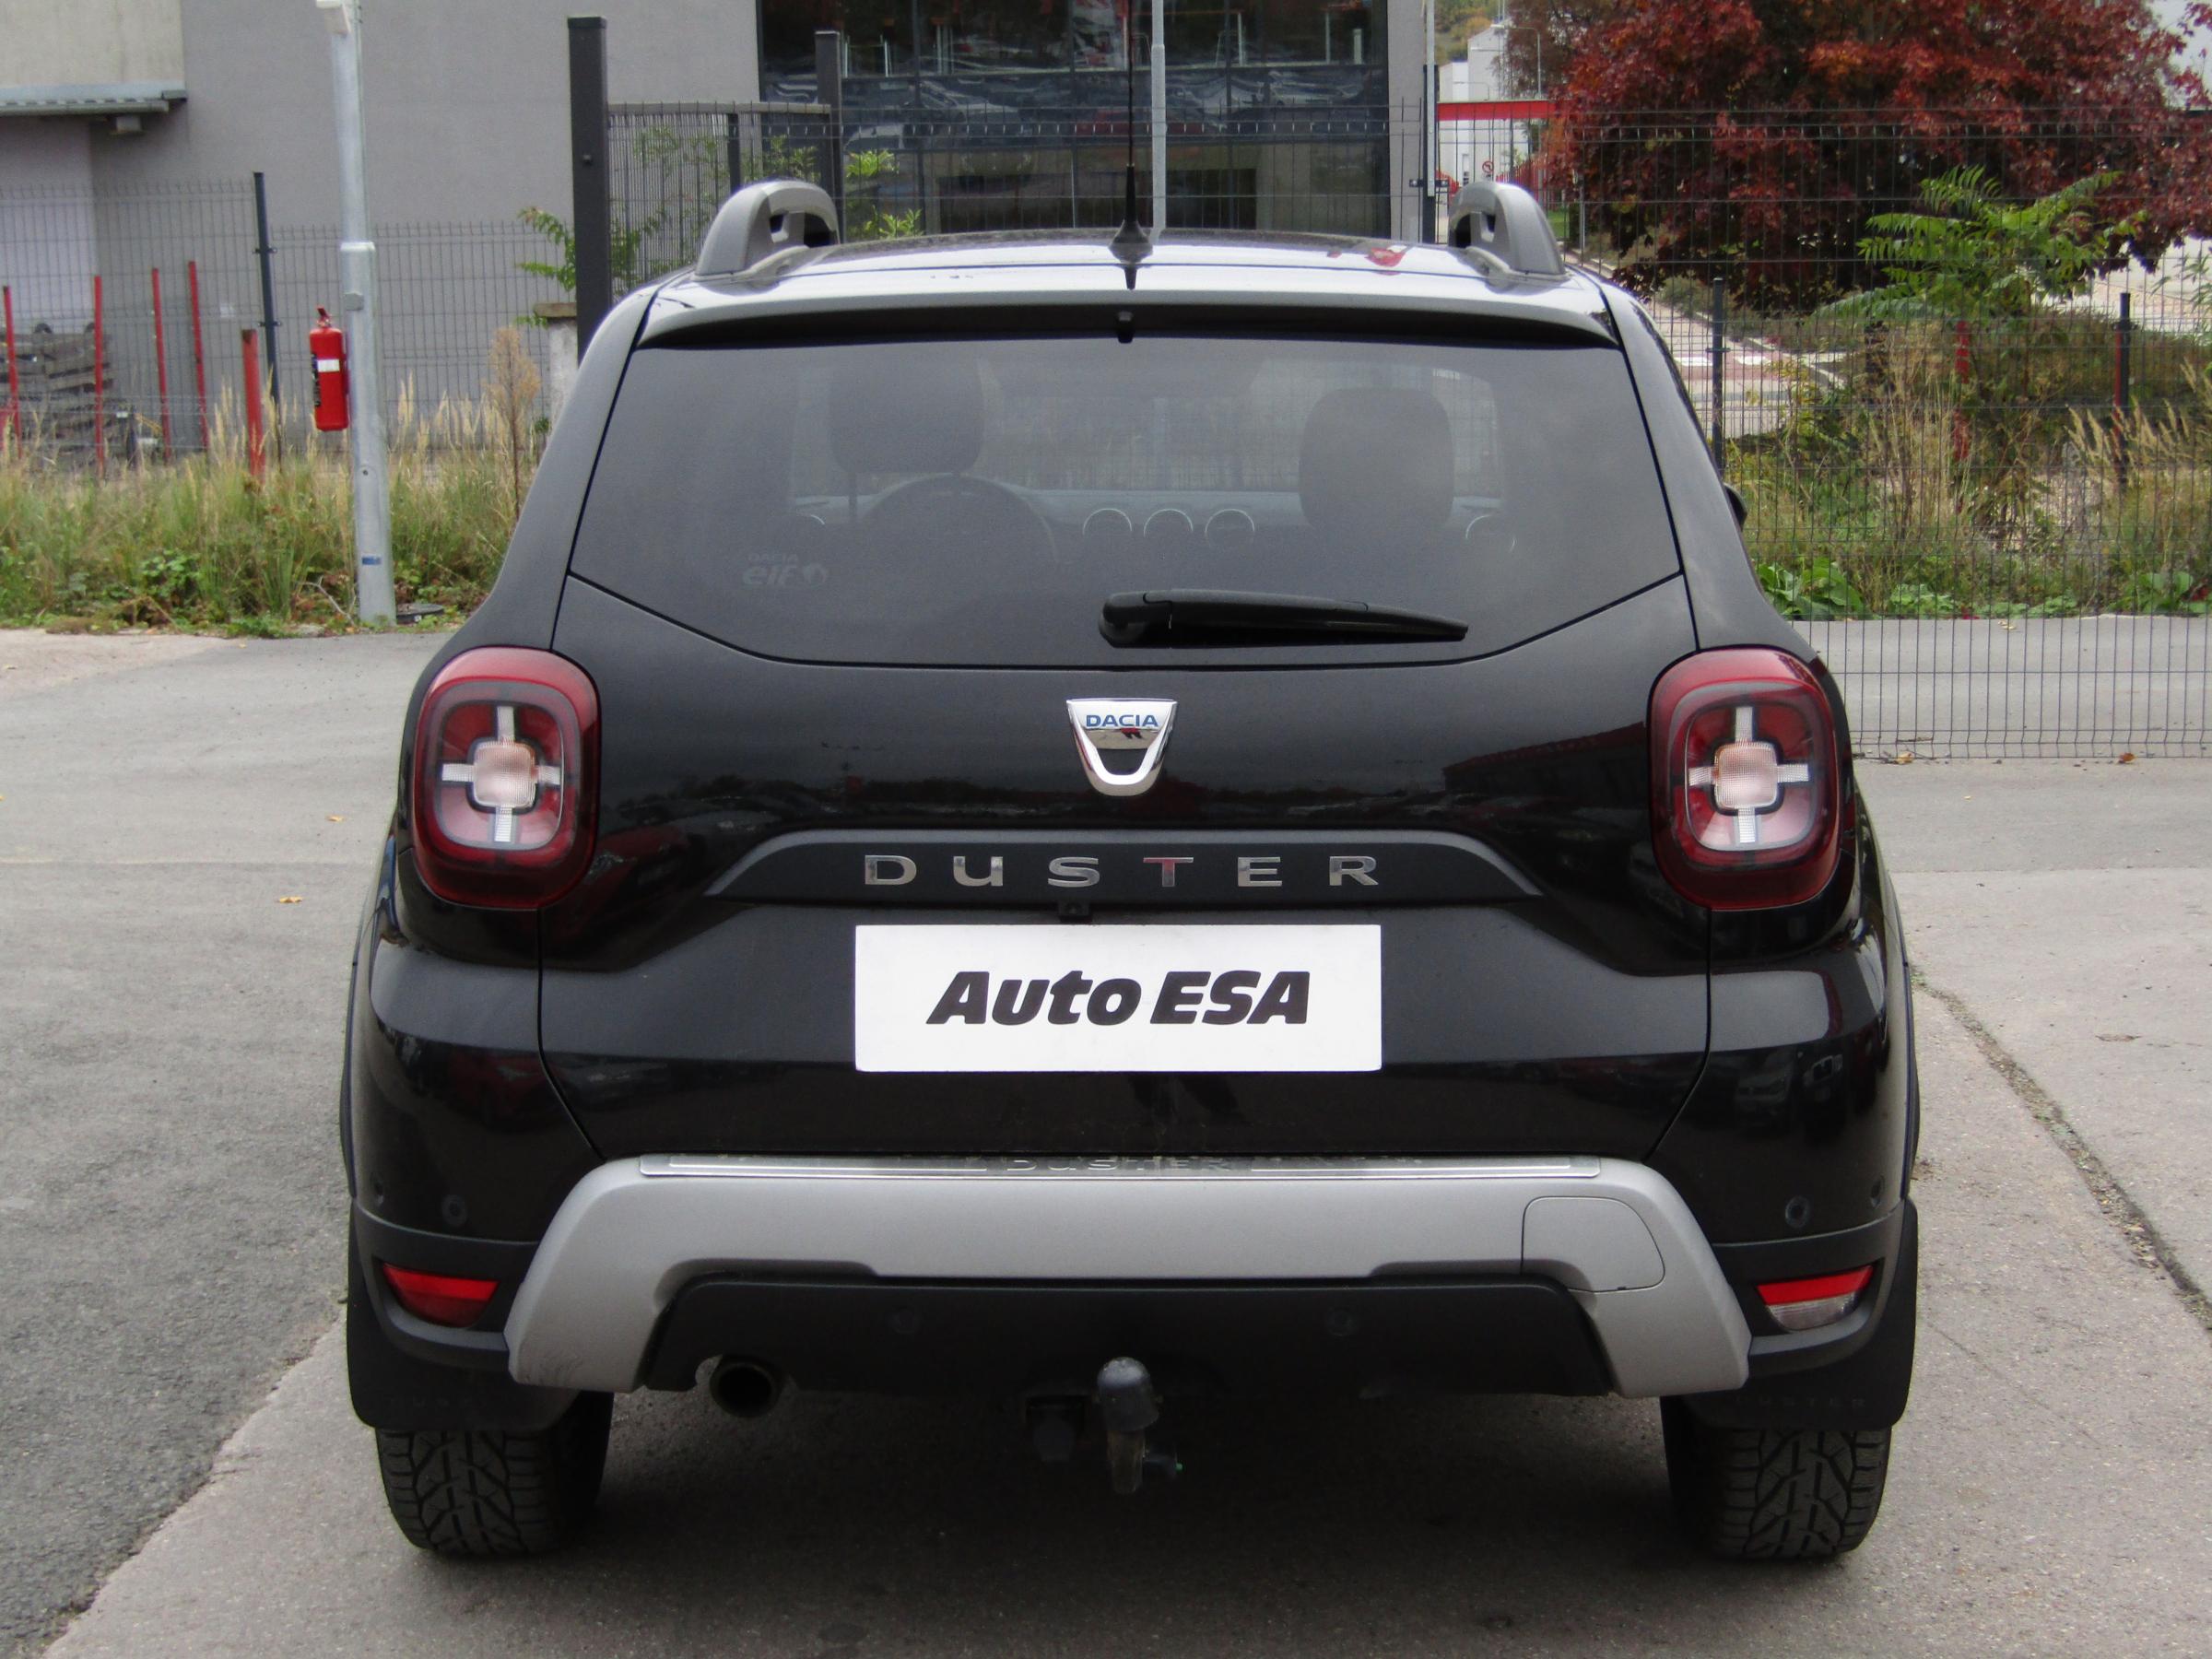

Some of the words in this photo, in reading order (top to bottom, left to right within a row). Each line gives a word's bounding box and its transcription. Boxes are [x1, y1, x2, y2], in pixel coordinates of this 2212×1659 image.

[1086, 714, 1159, 727] DACIA
[865, 854, 1379, 888] DUSTER
[925, 970, 1142, 1026] Auto
[1149, 970, 1311, 1026] ESA
